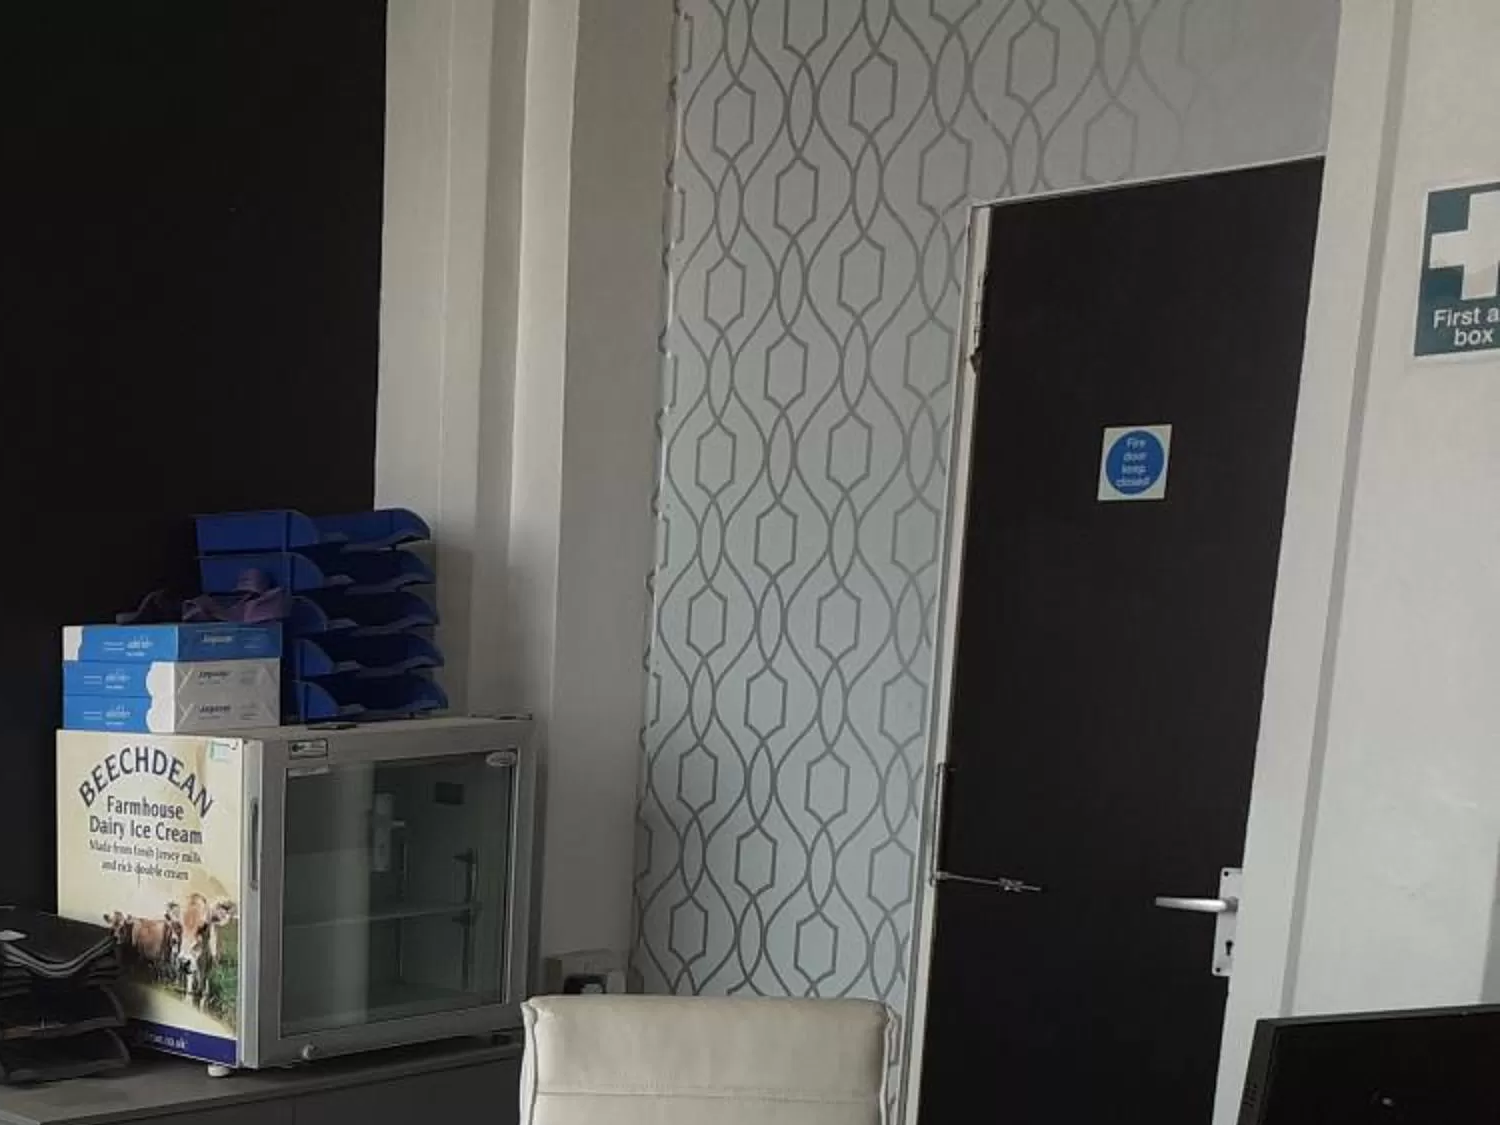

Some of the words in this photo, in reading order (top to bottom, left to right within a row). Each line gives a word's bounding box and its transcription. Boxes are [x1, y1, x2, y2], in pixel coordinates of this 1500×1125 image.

[1433, 307, 1481, 329] First
[1453, 327, 1494, 346] box
[1127, 437, 1147, 449] Fire
[1123, 451, 1149, 462] door
[1122, 463, 1149, 475] keep
[1115, 476, 1151, 488] closed
[79, 746, 213, 819] BEECHDEAN
[107, 795, 185, 820] Farmhouse
[89, 815, 125, 841] Dairy
[130, 819, 151, 839] Ice
[155, 822, 203, 845] Cream
[89, 839, 111, 853] Made
[113, 841, 133, 856] from
[181, 850, 202, 864] milk
[101, 860, 117, 871] and
[118, 859, 133, 873] rich
[134, 863, 162, 877] double
